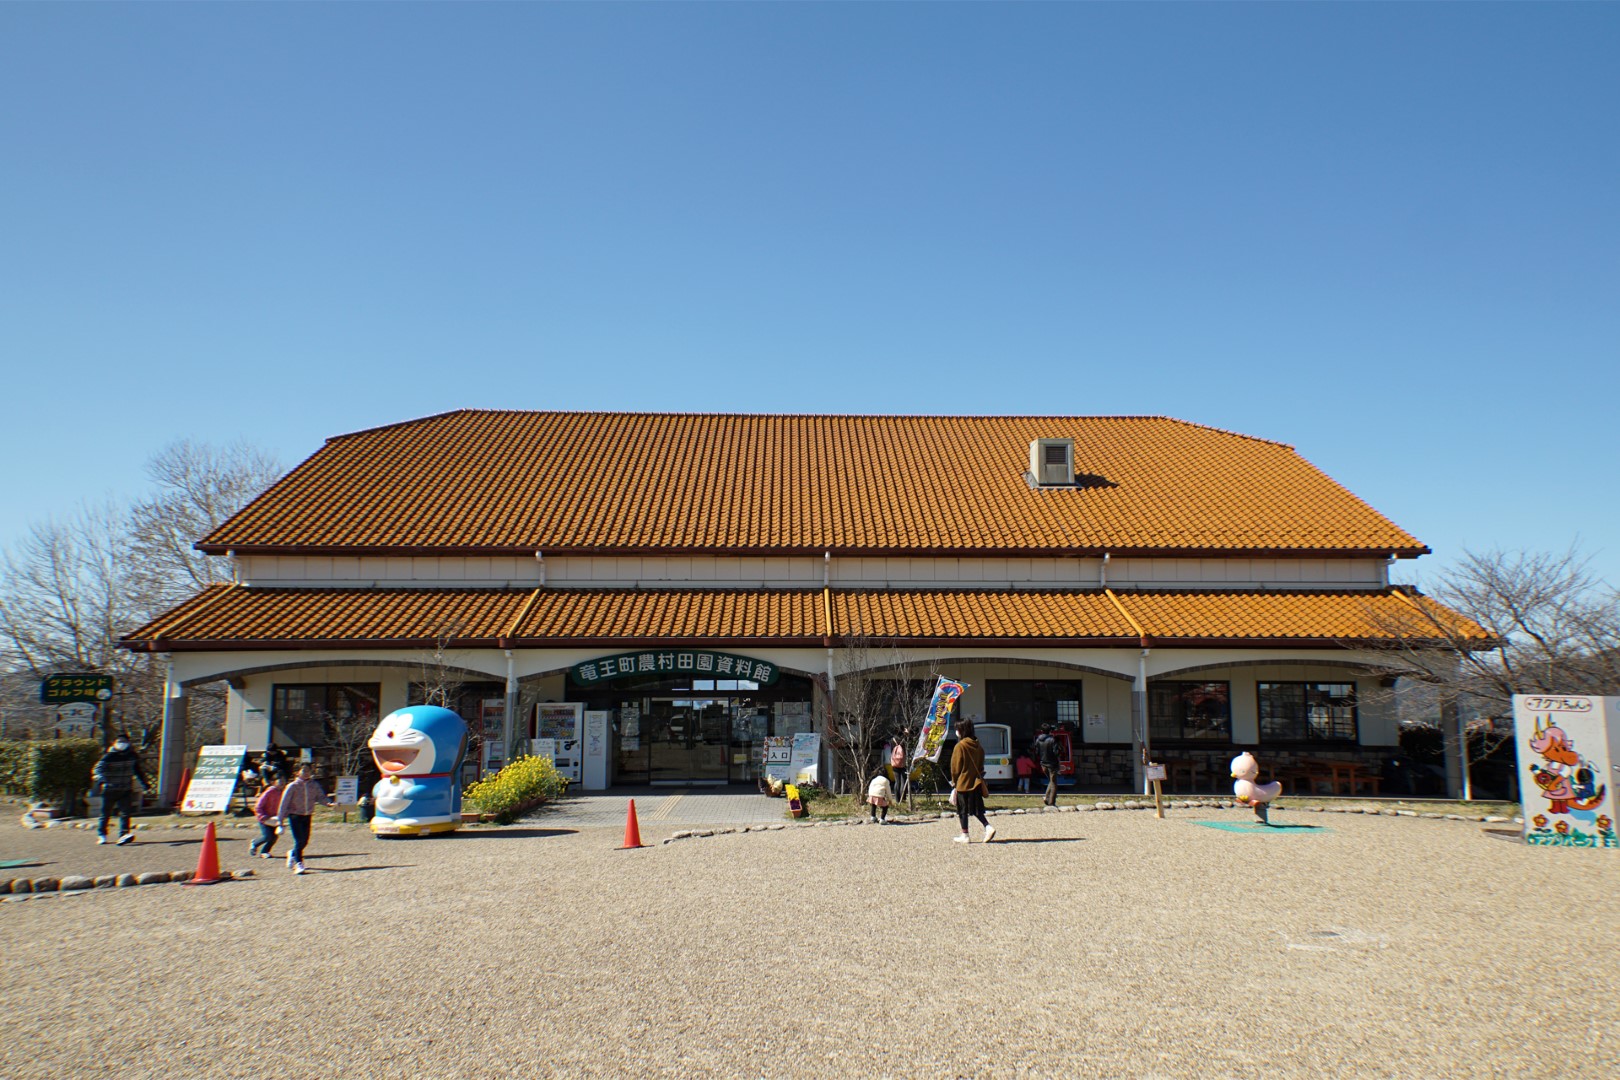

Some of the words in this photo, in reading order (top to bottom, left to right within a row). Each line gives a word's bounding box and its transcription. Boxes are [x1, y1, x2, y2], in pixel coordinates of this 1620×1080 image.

[578, 652, 772, 683] 竜王町農村田園資料館
[48, 678, 107, 687] グラウンド
[1531, 697, 1587, 710] アグリちゃん
[770, 751, 788, 760] 入口
[194, 801, 215, 809] 入口
